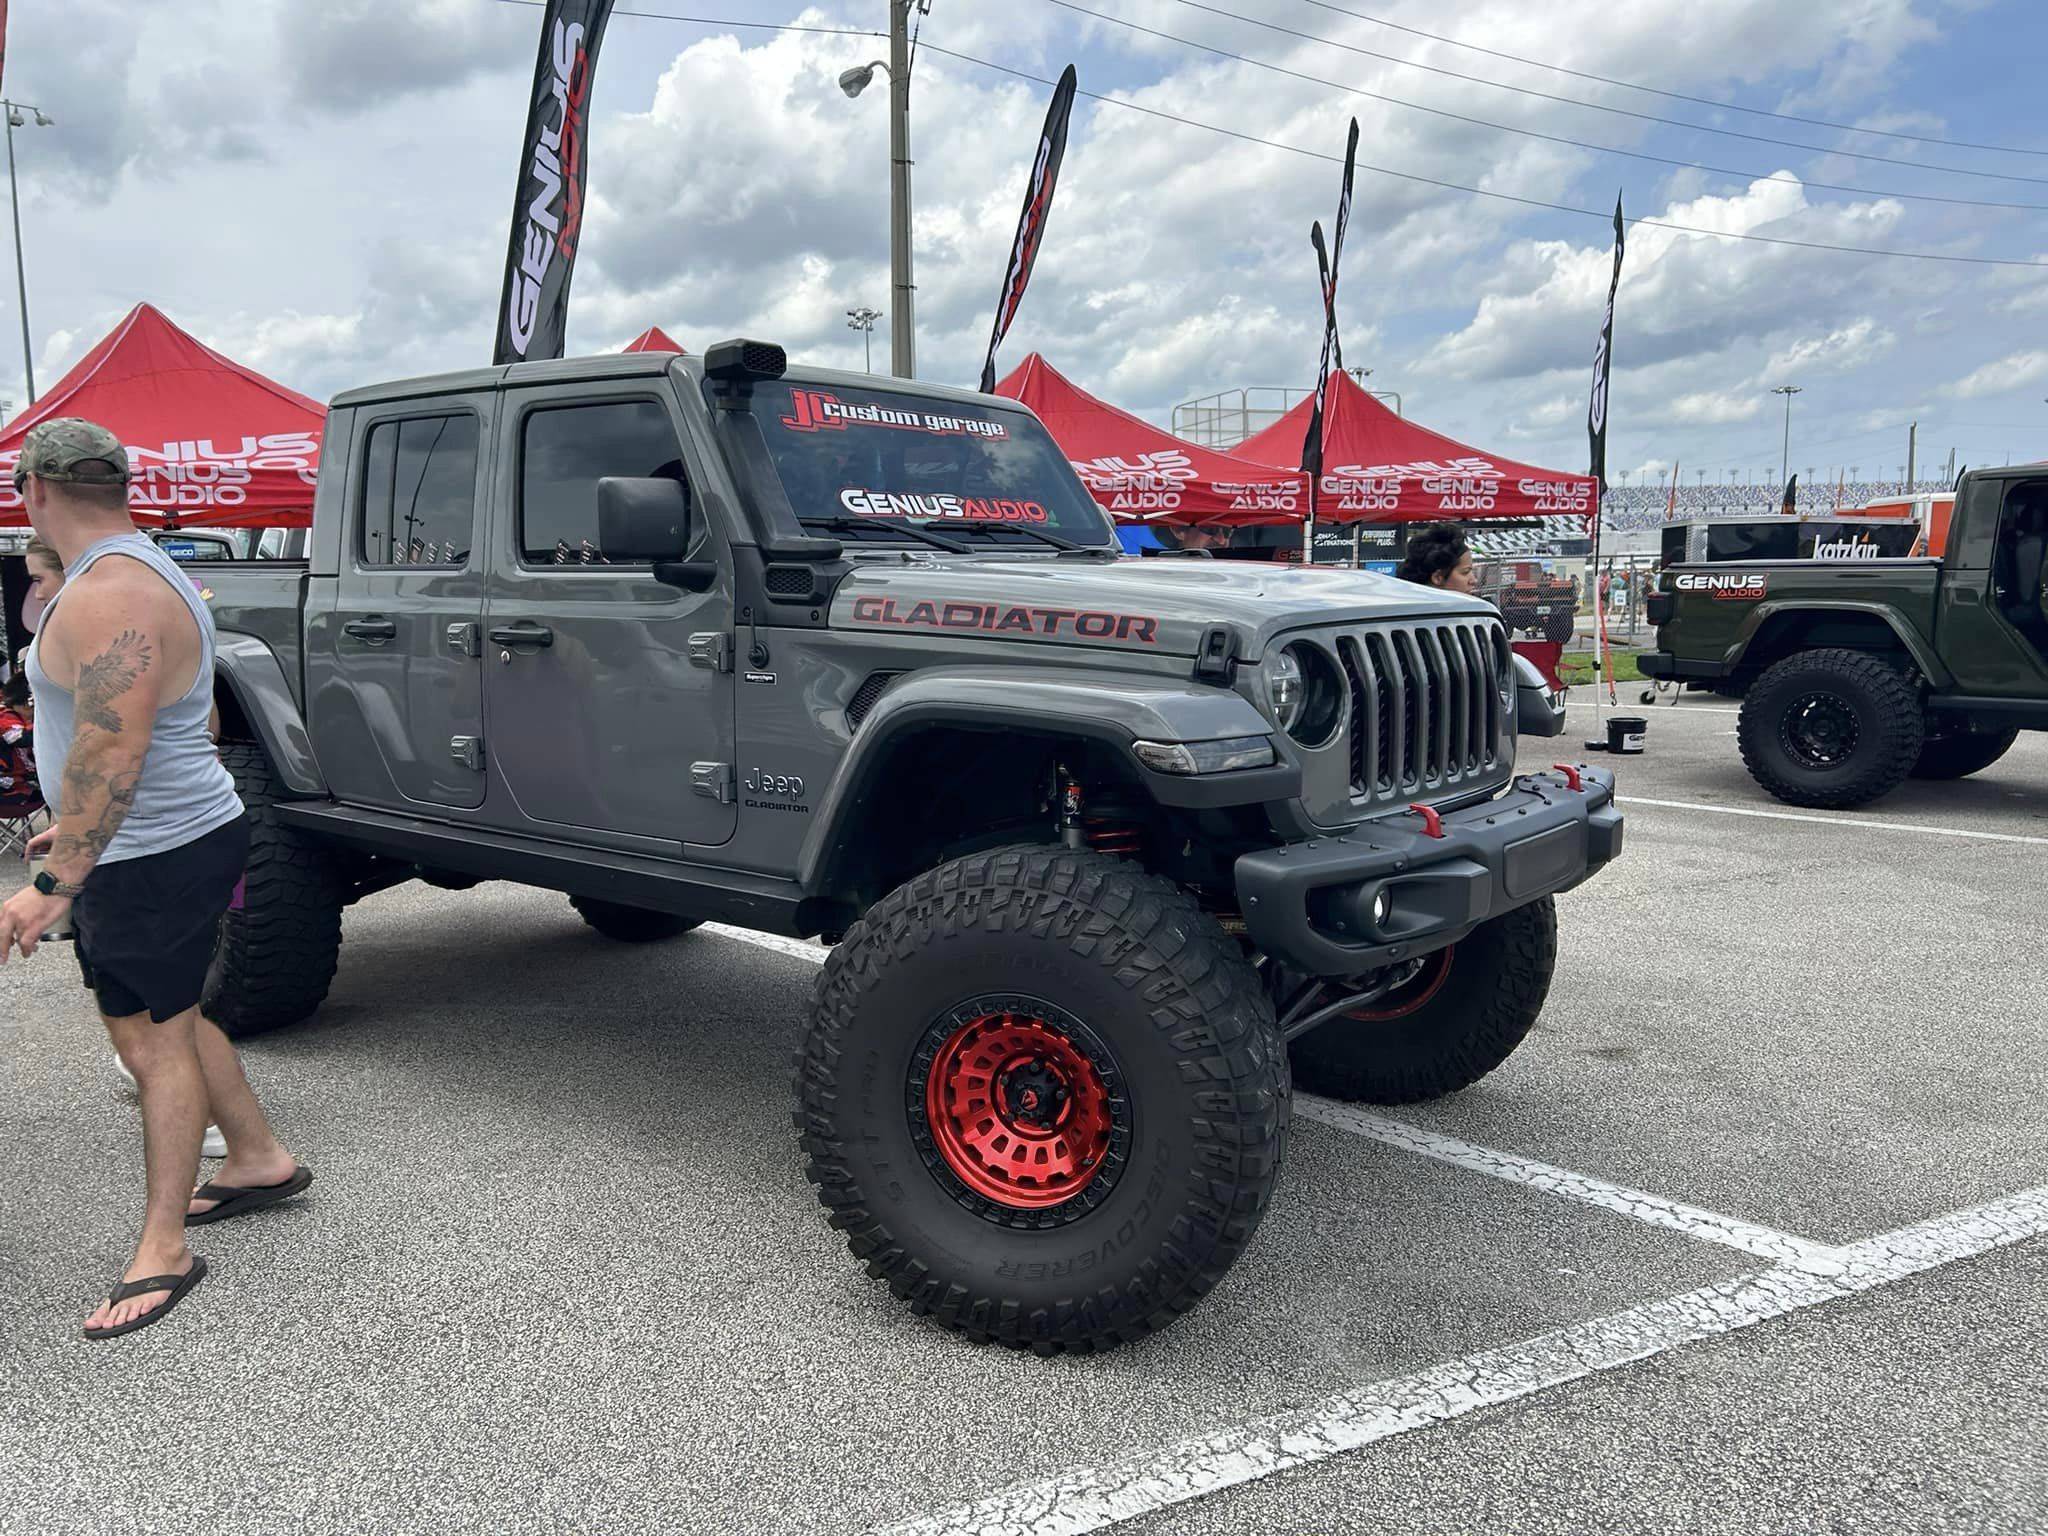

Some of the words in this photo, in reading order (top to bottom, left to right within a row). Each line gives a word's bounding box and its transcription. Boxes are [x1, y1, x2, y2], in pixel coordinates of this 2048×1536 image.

[510, 17, 584, 356] GENIUS
[779, 389, 844, 431] JC
[823, 402, 922, 427] custom
[923, 413, 1006, 438] garage
[125, 432, 318, 462] NIUS
[1069, 450, 1191, 471] NIUS
[1090, 476, 1187, 491] GENIUS
[1211, 480, 1301, 495] GENIUS
[1321, 476, 1402, 495] GENIUS
[1422, 478, 1498, 495] GENIUS
[1518, 478, 1592, 497] GENIUS
[839, 489, 965, 518] GENIUS
[1110, 492, 1181, 508] AUDIO
[1229, 495, 1297, 511] AUDIO
[1337, 495, 1399, 510] AUDIO
[1438, 495, 1495, 510] AUDIO
[1534, 497, 1588, 511] AUDIO
[1812, 534, 1880, 560] katzkin
[1675, 573, 1765, 590] GENIUS
[1715, 588, 1765, 600] AUDIO
[853, 596, 1161, 643] GLADIATOR
[744, 767, 805, 802] Jeep
[744, 799, 809, 813] GLADIATOR
[992, 1136, 1176, 1281] DISCOVERER
